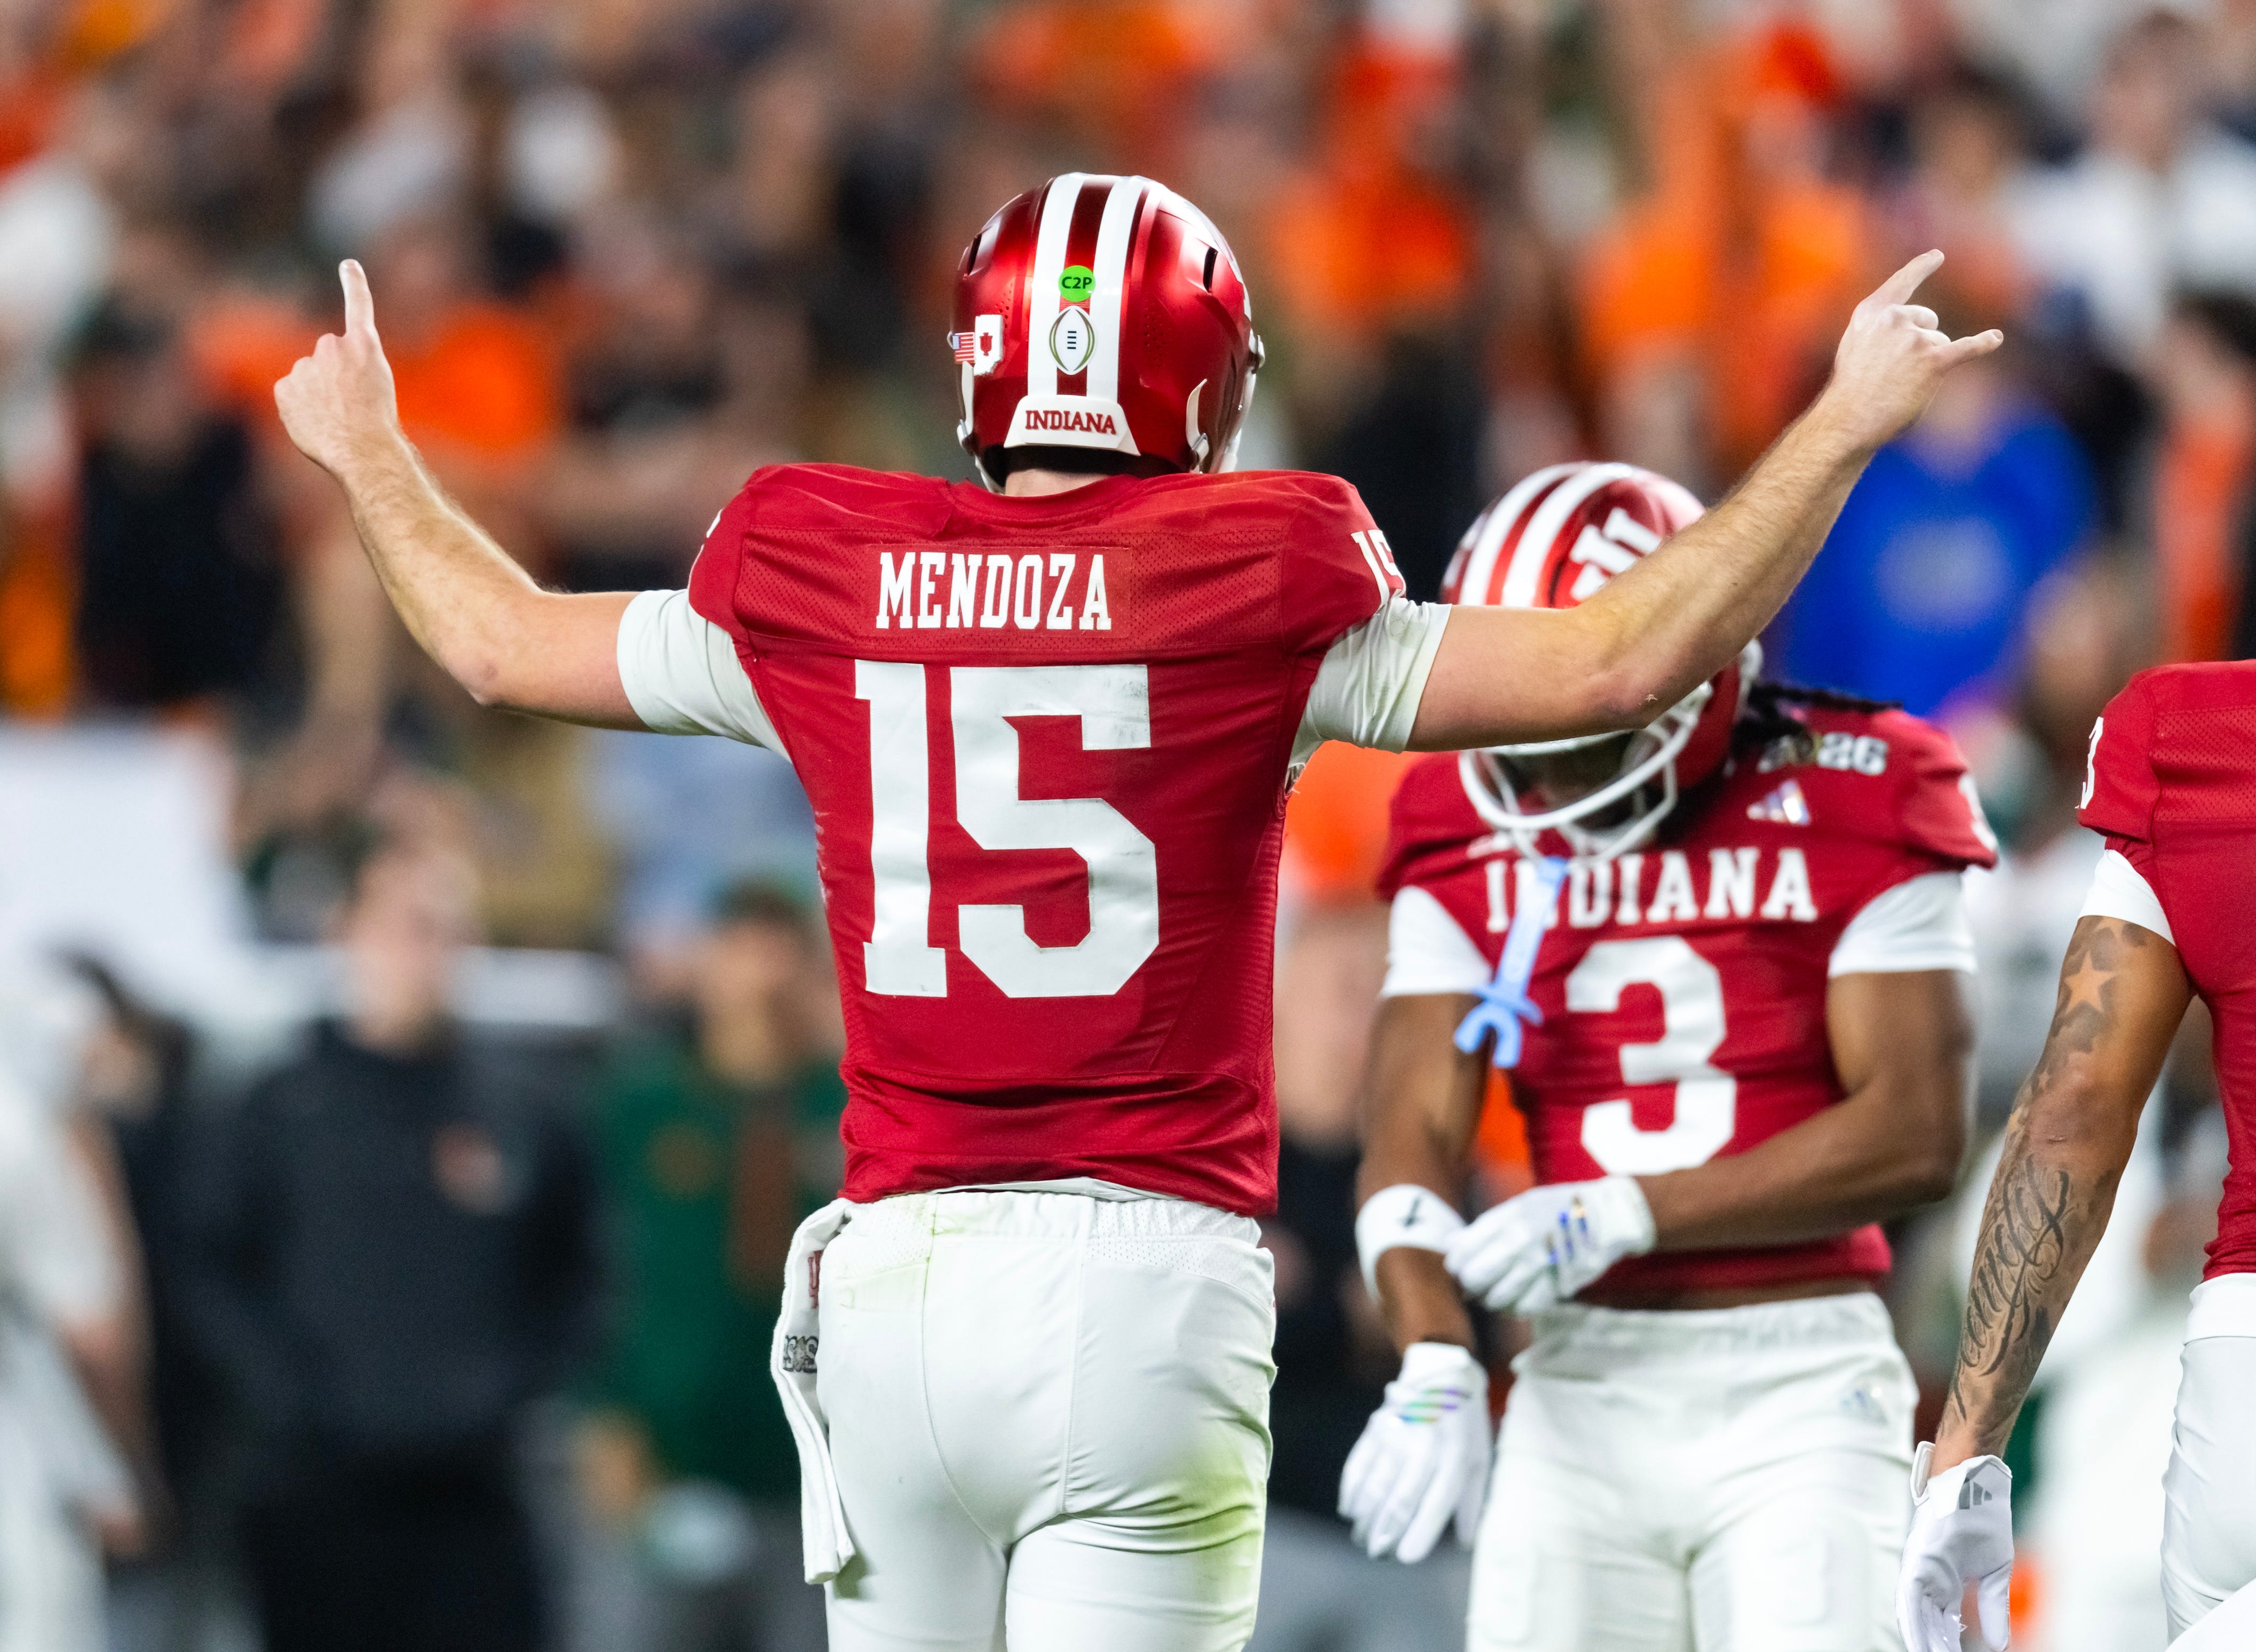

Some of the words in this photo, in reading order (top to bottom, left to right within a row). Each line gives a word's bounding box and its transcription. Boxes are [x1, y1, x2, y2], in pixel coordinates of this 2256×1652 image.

[1061, 276, 1092, 289] C2P
[1025, 410, 1116, 435] INDIANA
[876, 551, 1111, 630] MENDOZA
[854, 659, 1159, 998] 15
[1564, 935, 1737, 1176] 3
